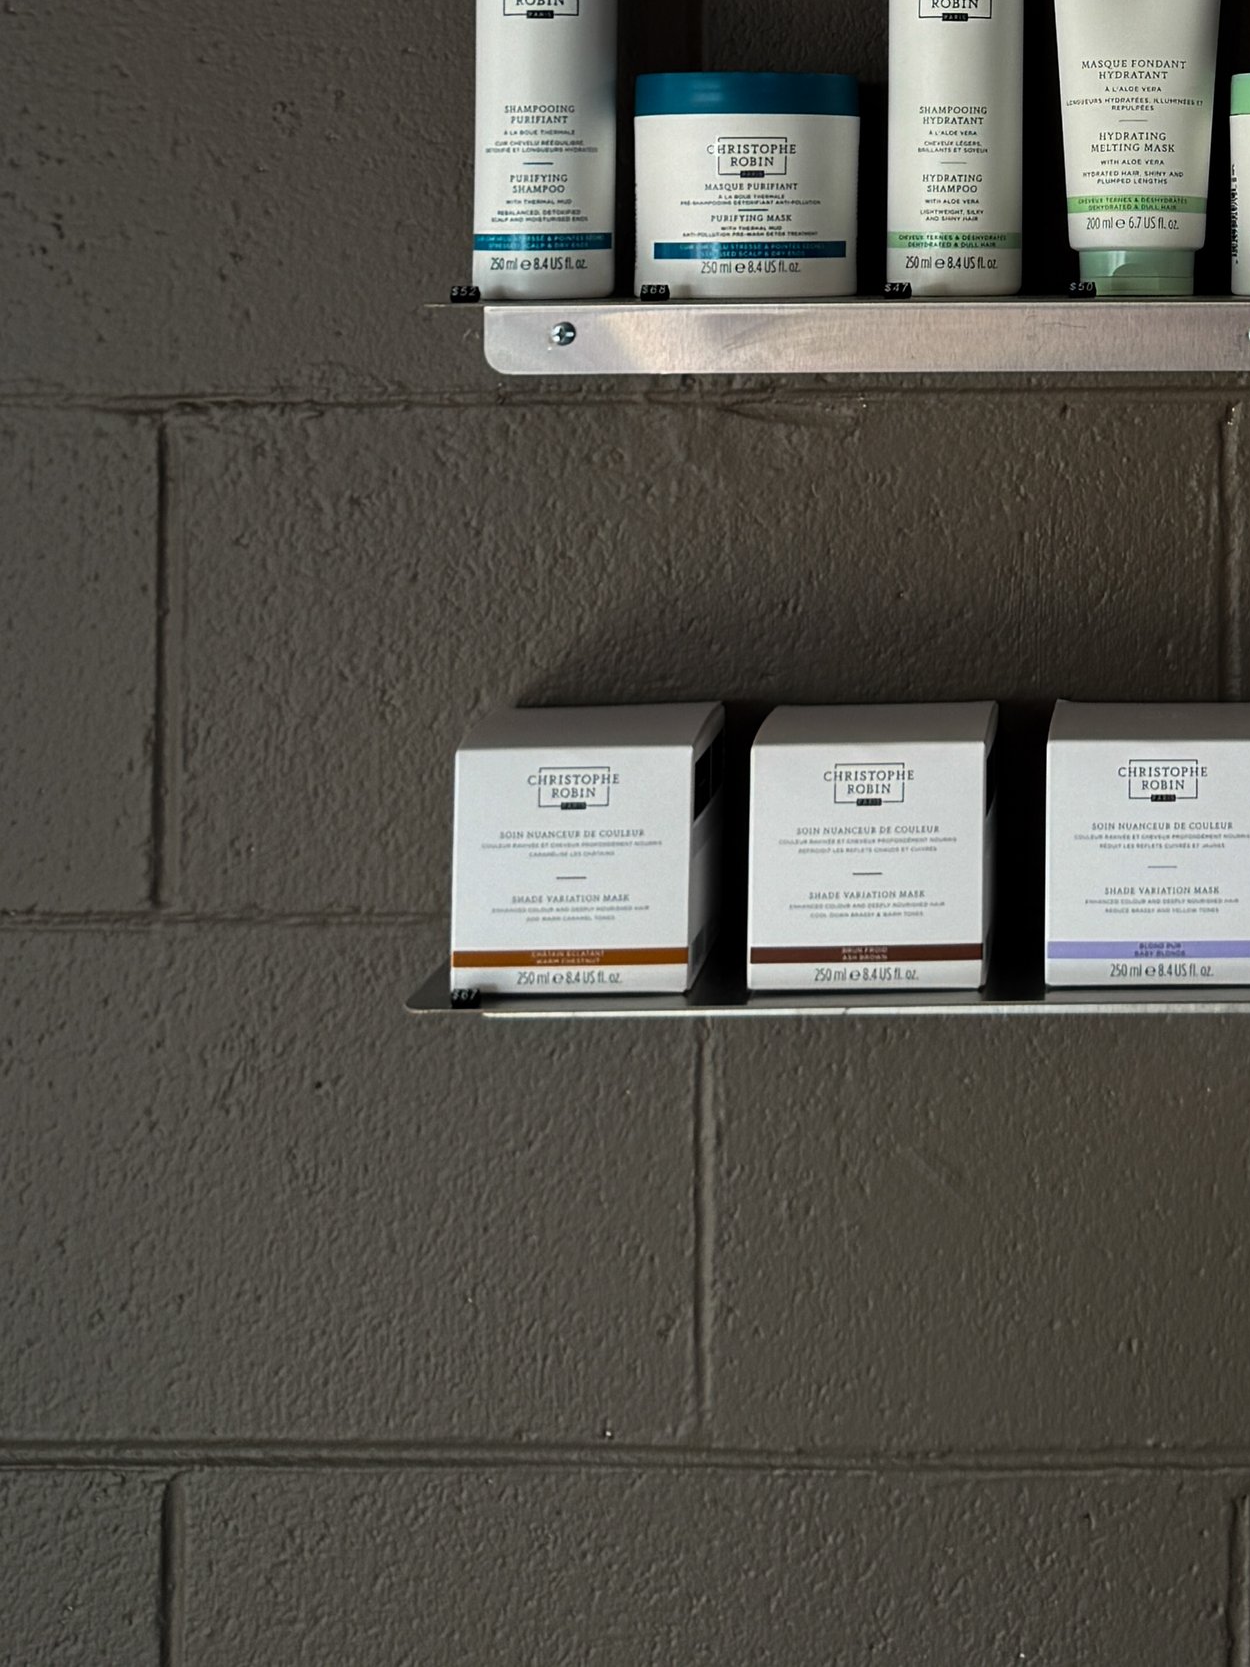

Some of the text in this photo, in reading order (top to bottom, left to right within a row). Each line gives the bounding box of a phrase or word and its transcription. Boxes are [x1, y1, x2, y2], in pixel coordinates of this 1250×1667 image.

[1082, 60, 1186, 70] MASQUE FONDANT
[1099, 71, 1168, 79] HYDRATANT
[504, 105, 575, 113] SHAMPOOING
[511, 115, 568, 124] PURIFIANT
[1099, 132, 1166, 141] HYDRATING
[707, 144, 796, 154] CHRISTOPHE
[1091, 144, 1175, 152] MELTING MASK
[730, 157, 774, 166] ROBIN
[510, 174, 568, 183] PURIFYING
[512, 185, 565, 194] SHAMPOO
[824, 770, 914, 782] CHRISTOPHE
[1118, 767, 1208, 777] CHRISTOPHE
[528, 774, 620, 786] CHRISTOPHE
[847, 784, 891, 795] ROBIN
[1141, 780, 1185, 790] ROBIN
[551, 788, 596, 799] ROBIN
[1092, 822, 1233, 830] SOIN NUANCEUR DE COULEUR
[1105, 886, 1219, 895] SHADE VARIATION MASK
